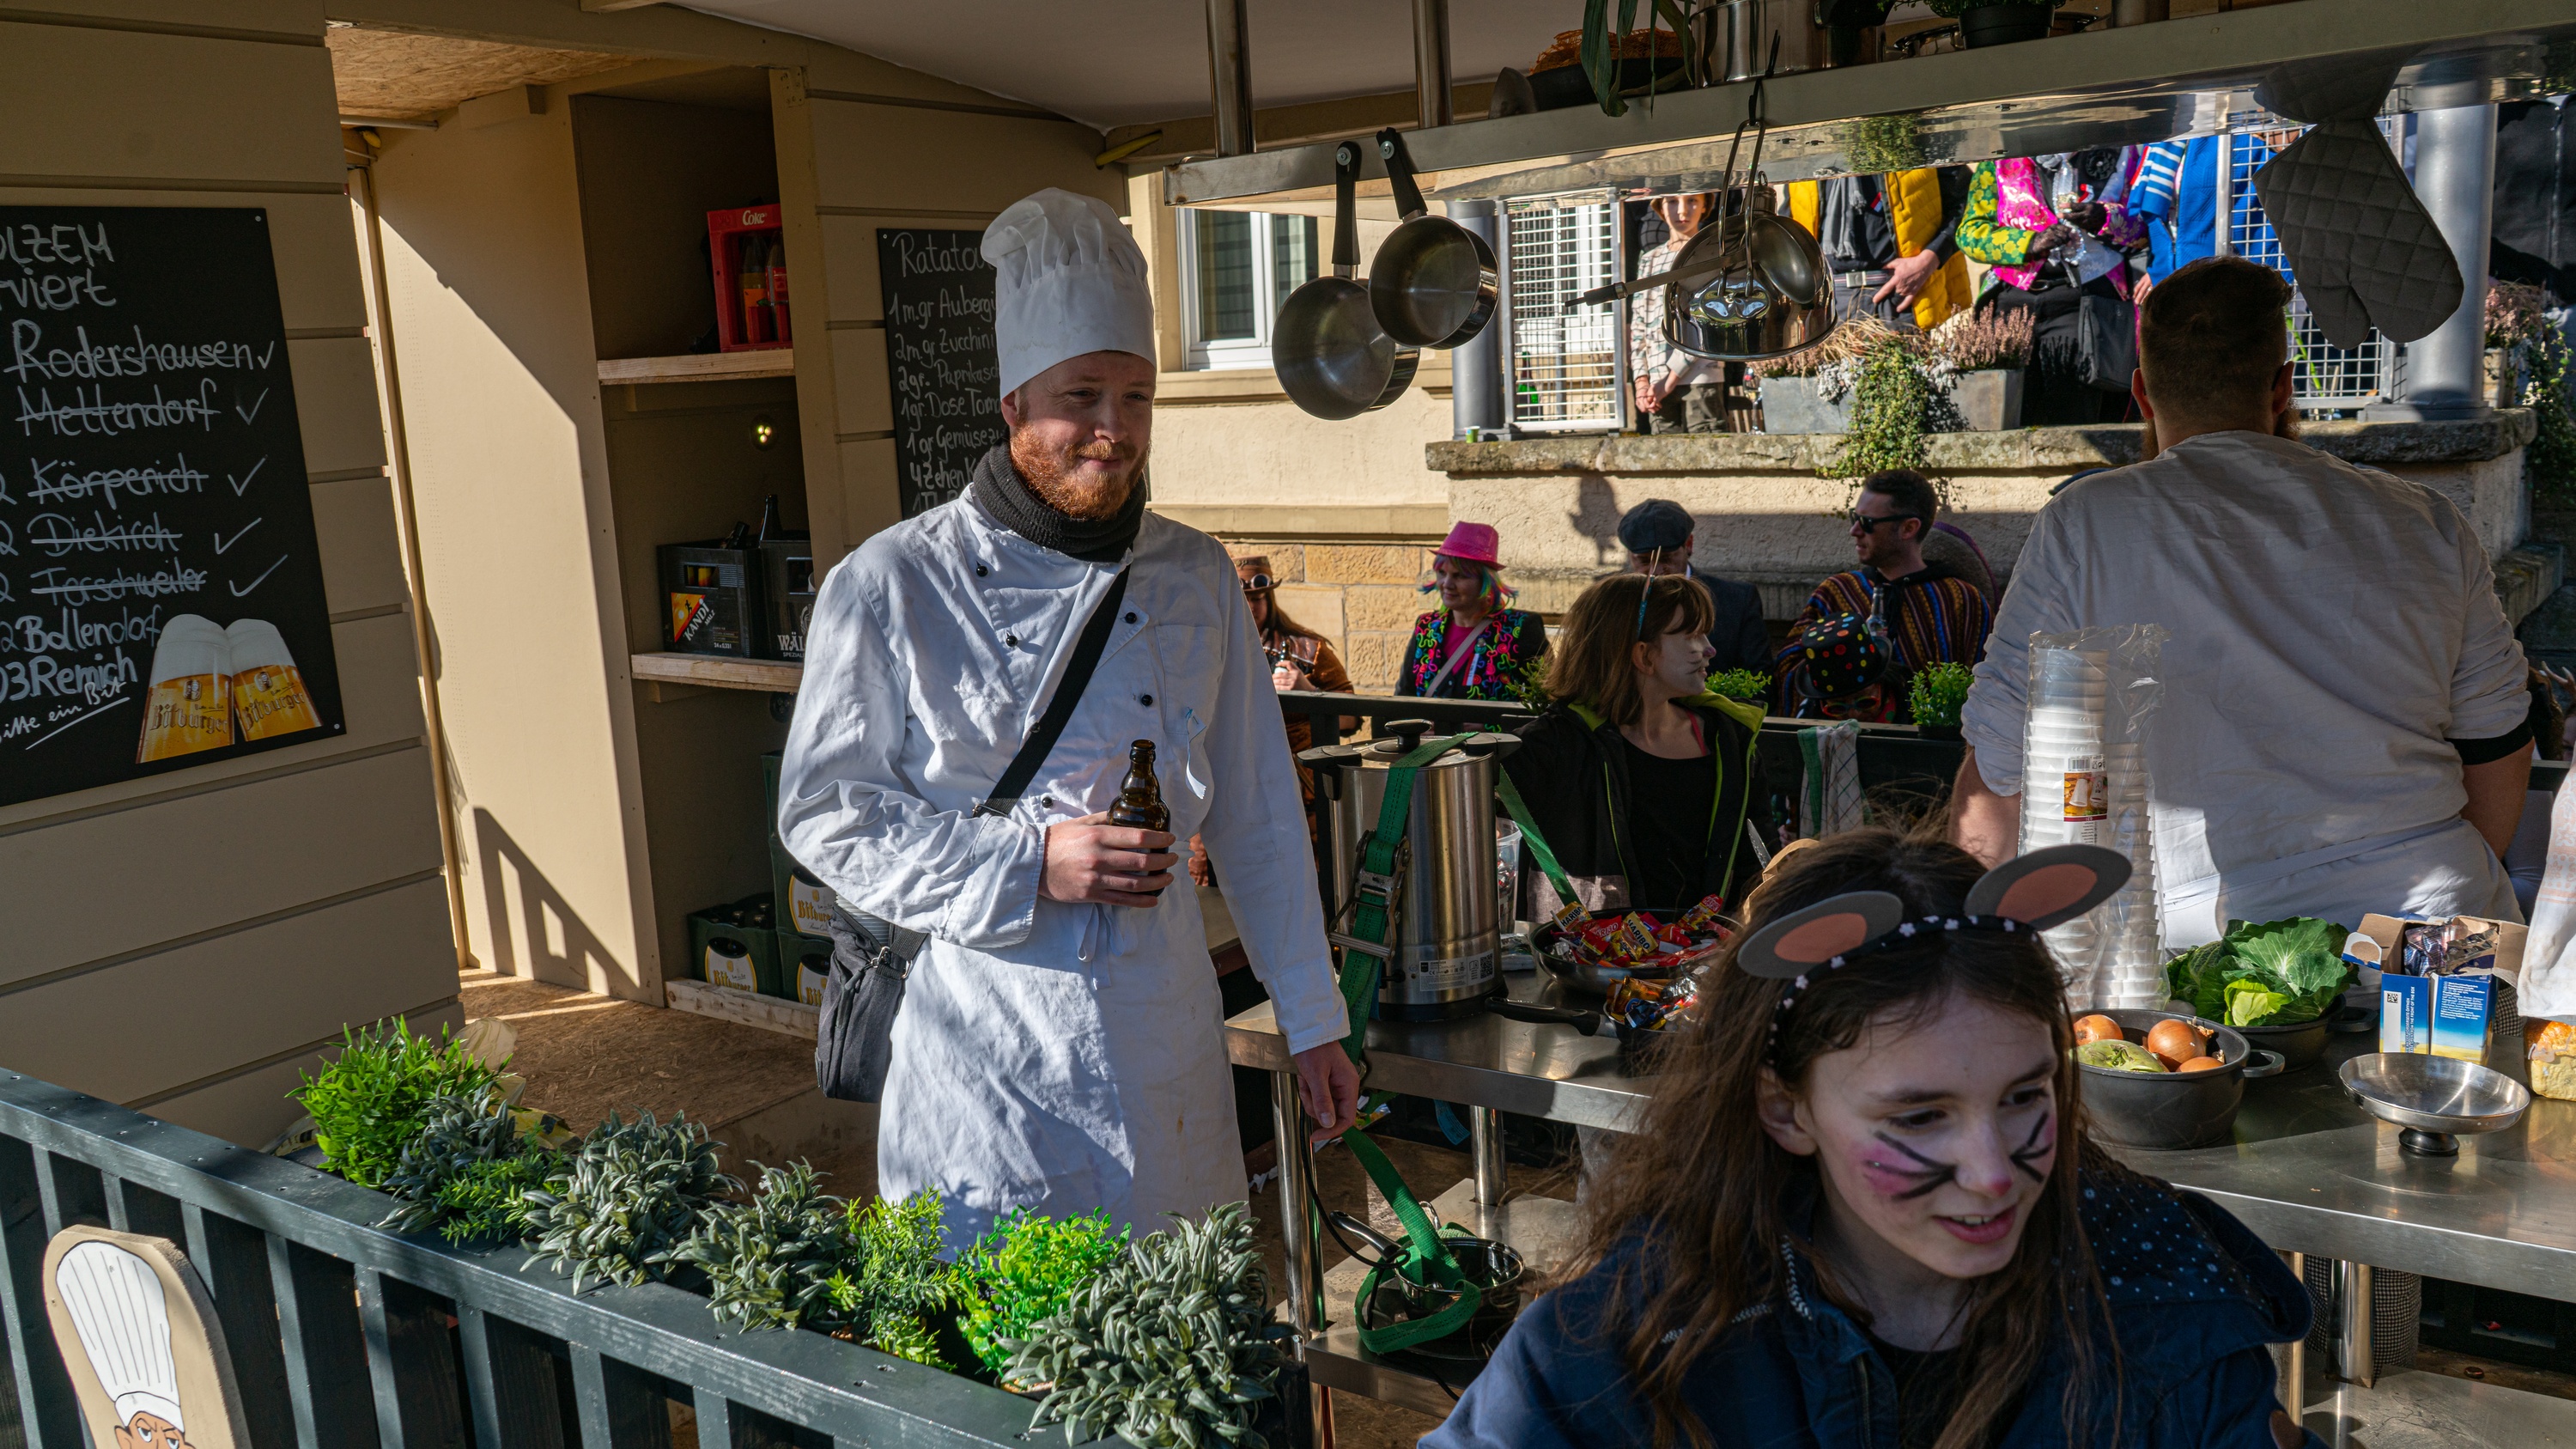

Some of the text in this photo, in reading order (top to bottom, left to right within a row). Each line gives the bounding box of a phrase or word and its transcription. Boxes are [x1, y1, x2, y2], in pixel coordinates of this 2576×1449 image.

[742, 210, 766, 226] Coke
[892, 232, 994, 277] Ratatou
[12, 319, 254, 384] Rodershausen
[939, 326, 995, 354] Zucchini
[16, 378, 220, 436] Mettendorf
[925, 392, 968, 418] Dose
[30, 452, 206, 510] Körperich
[27, 510, 180, 557] Diekirch
[0, 676, 127, 744] itte ein Bit
[150, 703, 228, 734] Bitburger
[243, 691, 306, 731] Bitburger
[1560, 906, 1583, 927] HARIBO
[1595, 922, 1619, 938] ARIBO
